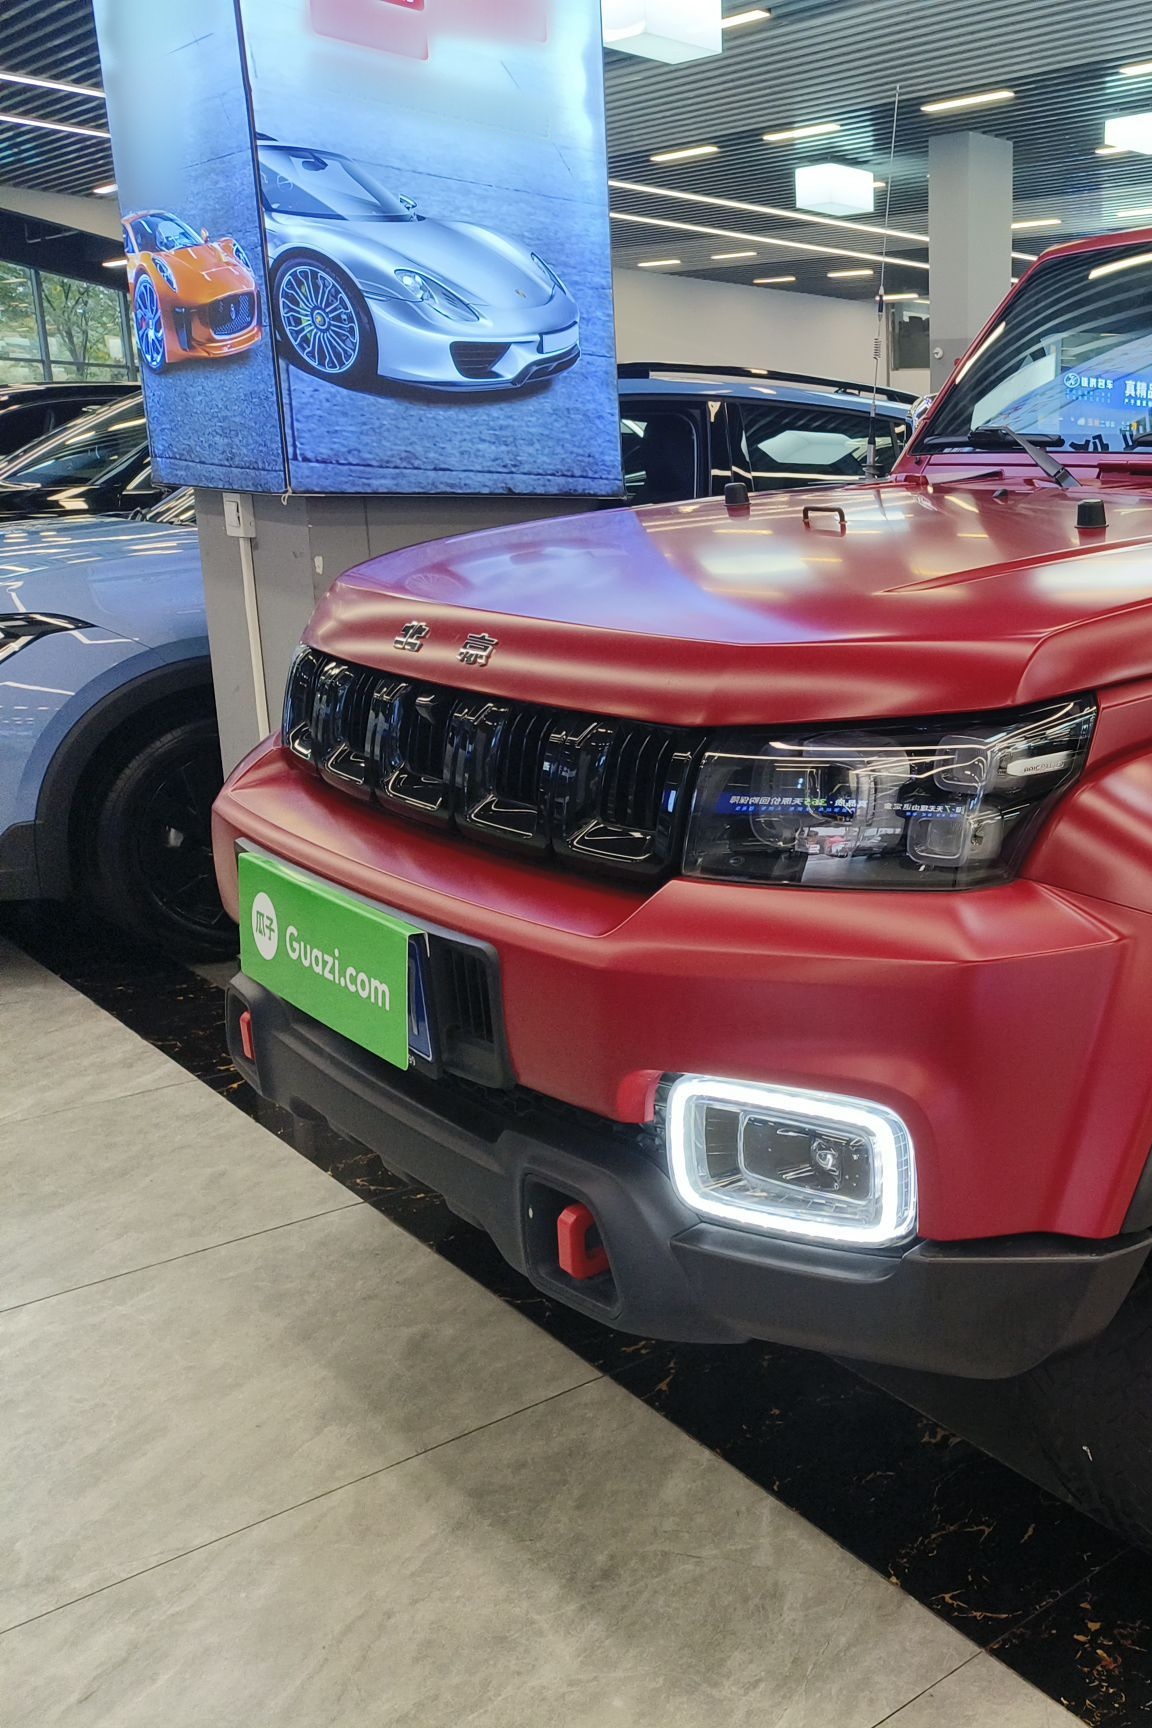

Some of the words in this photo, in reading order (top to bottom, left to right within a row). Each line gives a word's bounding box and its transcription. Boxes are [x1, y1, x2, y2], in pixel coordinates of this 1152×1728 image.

[393, 621, 500, 667] 北京
[254, 910, 276, 942] 瓜子
[285, 924, 390, 1012] Guazi.com
